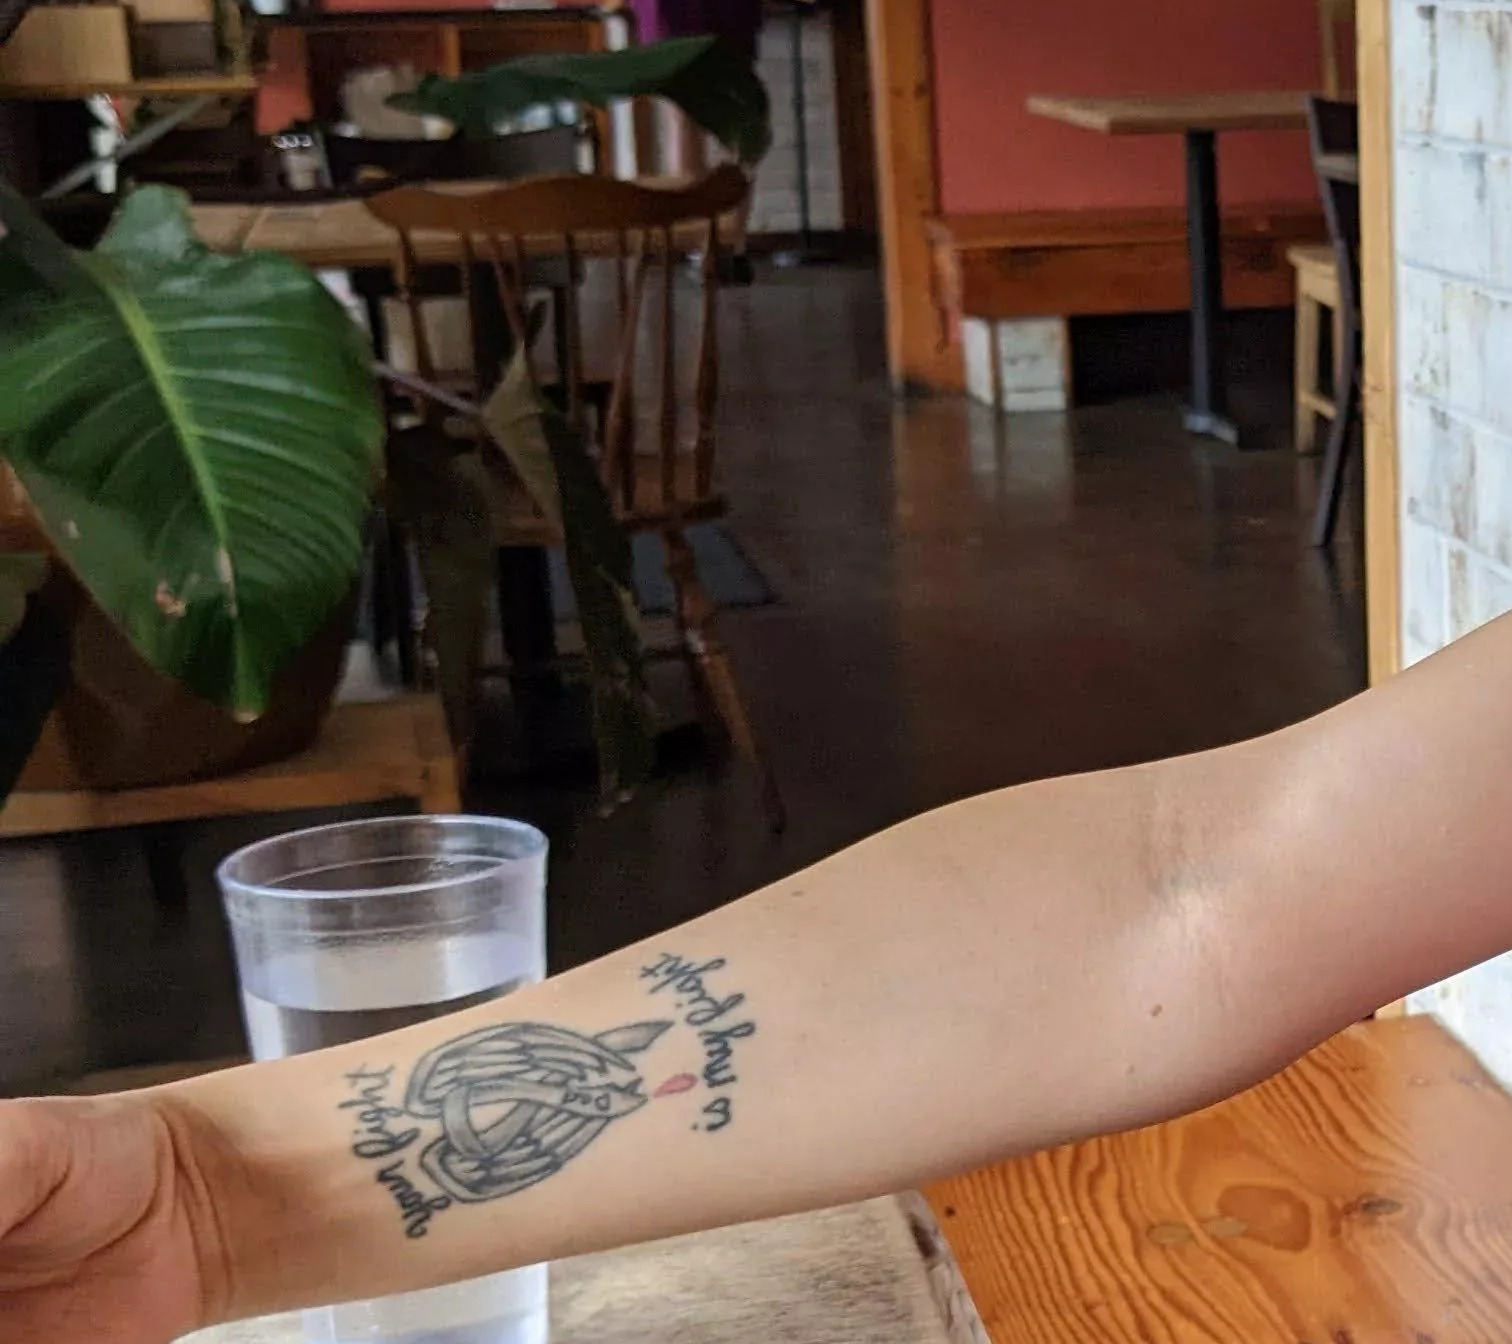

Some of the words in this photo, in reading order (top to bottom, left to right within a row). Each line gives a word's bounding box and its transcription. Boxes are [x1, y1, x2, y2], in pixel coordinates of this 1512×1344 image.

[639, 952, 746, 1026] fight
[702, 1018, 757, 1089] my
[338, 1062, 421, 1158] fight
[690, 1096, 732, 1133] is
[375, 1159, 452, 1239] your
